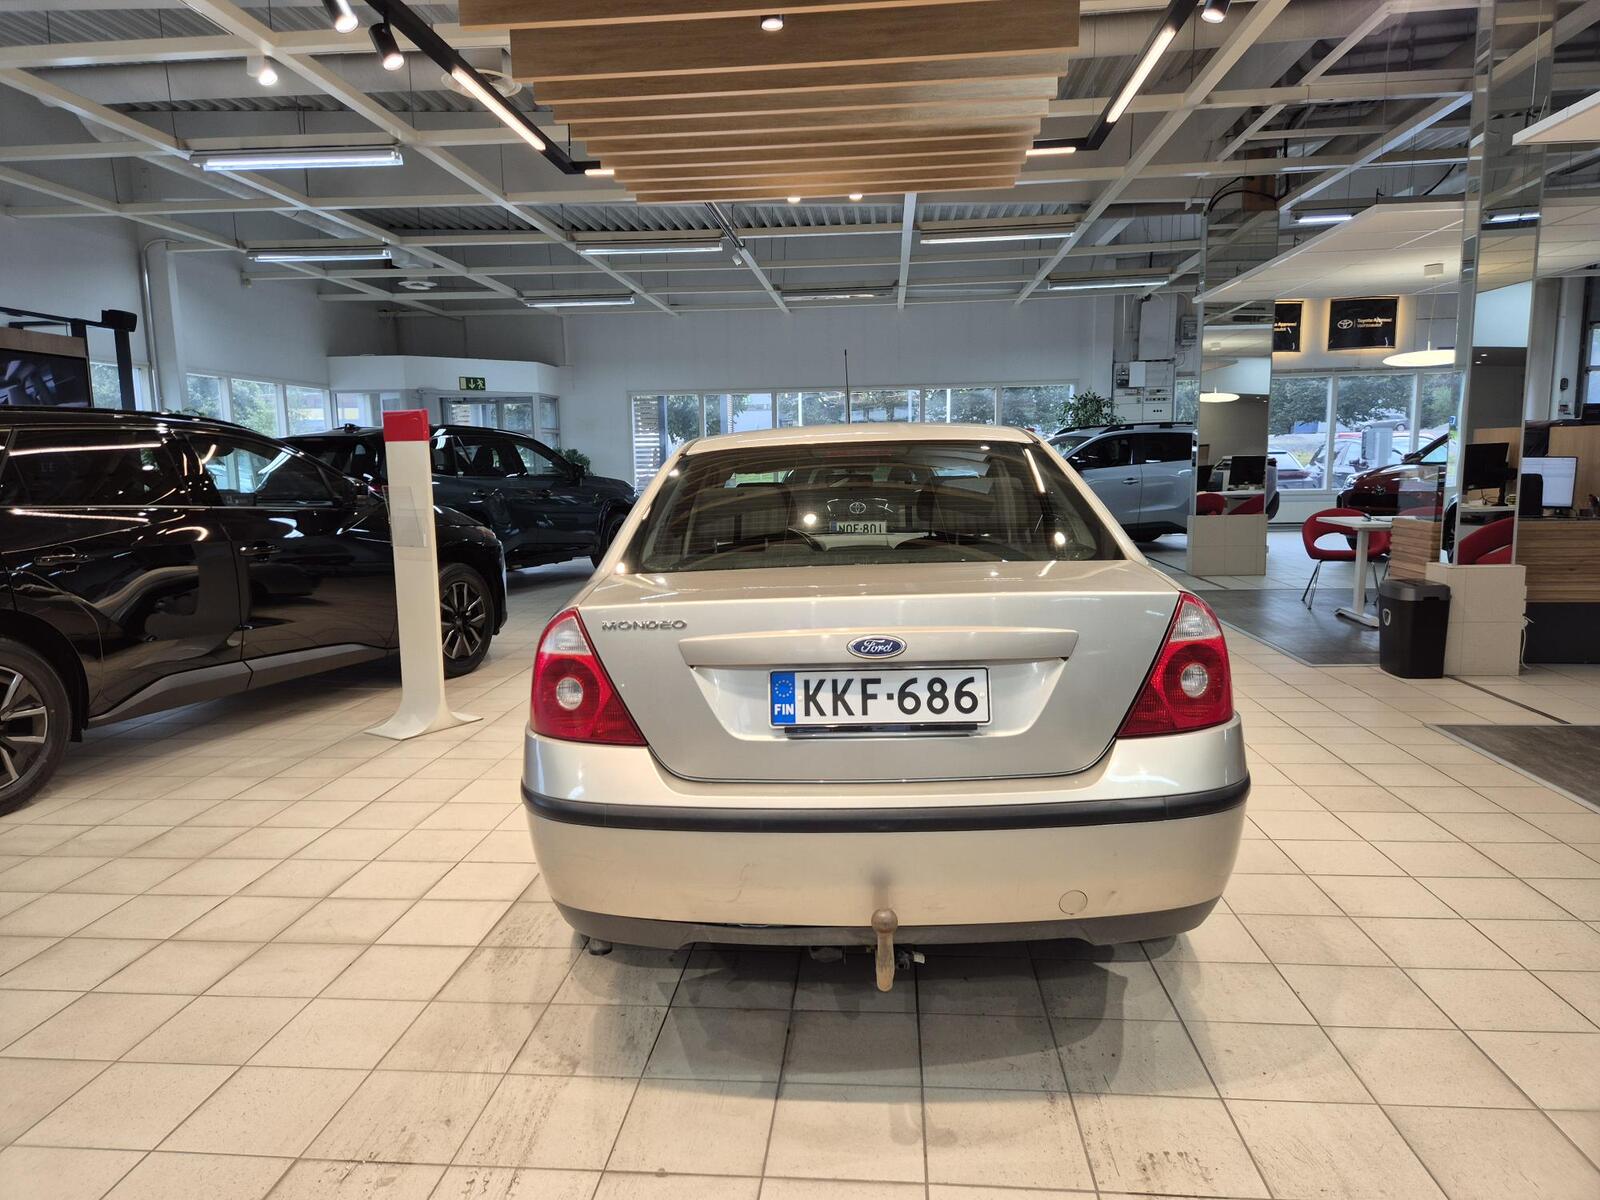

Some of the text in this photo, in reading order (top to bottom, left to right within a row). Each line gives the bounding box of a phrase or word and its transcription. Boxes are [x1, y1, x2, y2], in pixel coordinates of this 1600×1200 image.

[602, 620, 687, 631] MONDEO
[861, 639, 893, 652] Ford
[803, 676, 979, 717] KKF-686
[775, 704, 794, 715] FIN
